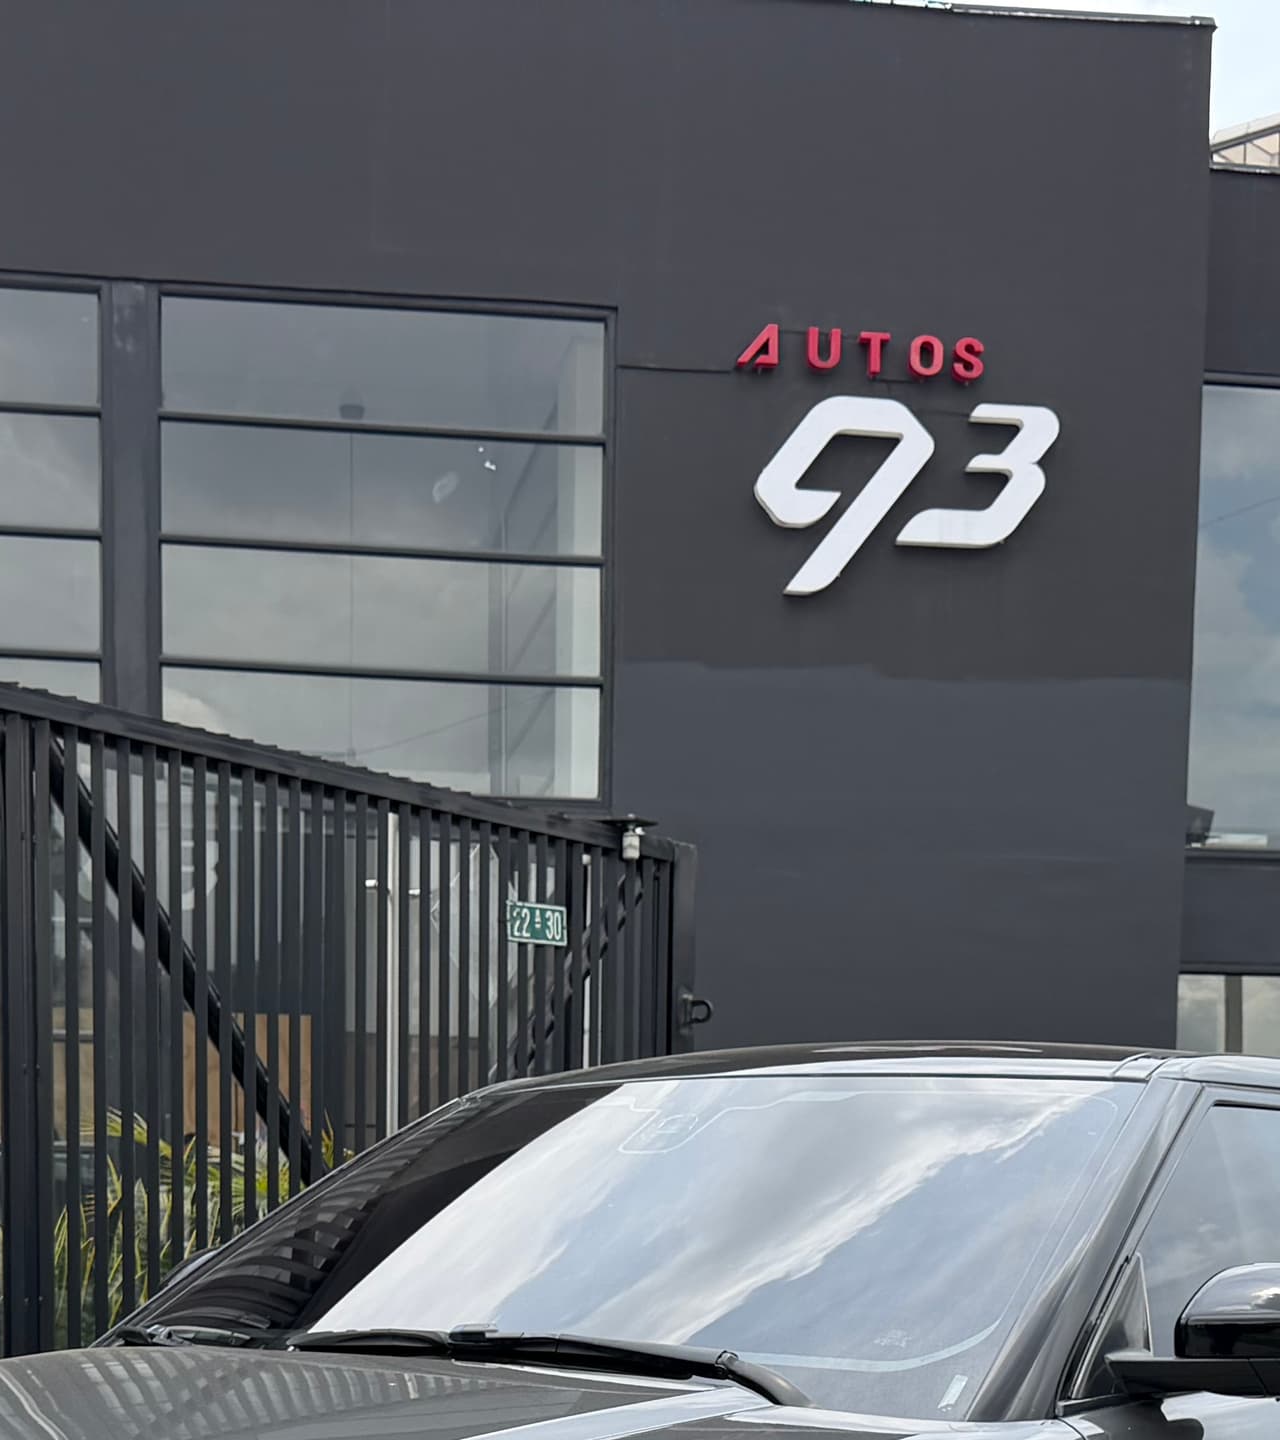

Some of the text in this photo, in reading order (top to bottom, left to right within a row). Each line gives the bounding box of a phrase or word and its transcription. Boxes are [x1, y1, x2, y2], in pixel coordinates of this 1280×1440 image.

[736, 323, 985, 382] AUTOS
[753, 395, 1060, 595] 93
[513, 907, 531, 937] 22
[545, 910, 562, 940] 30
